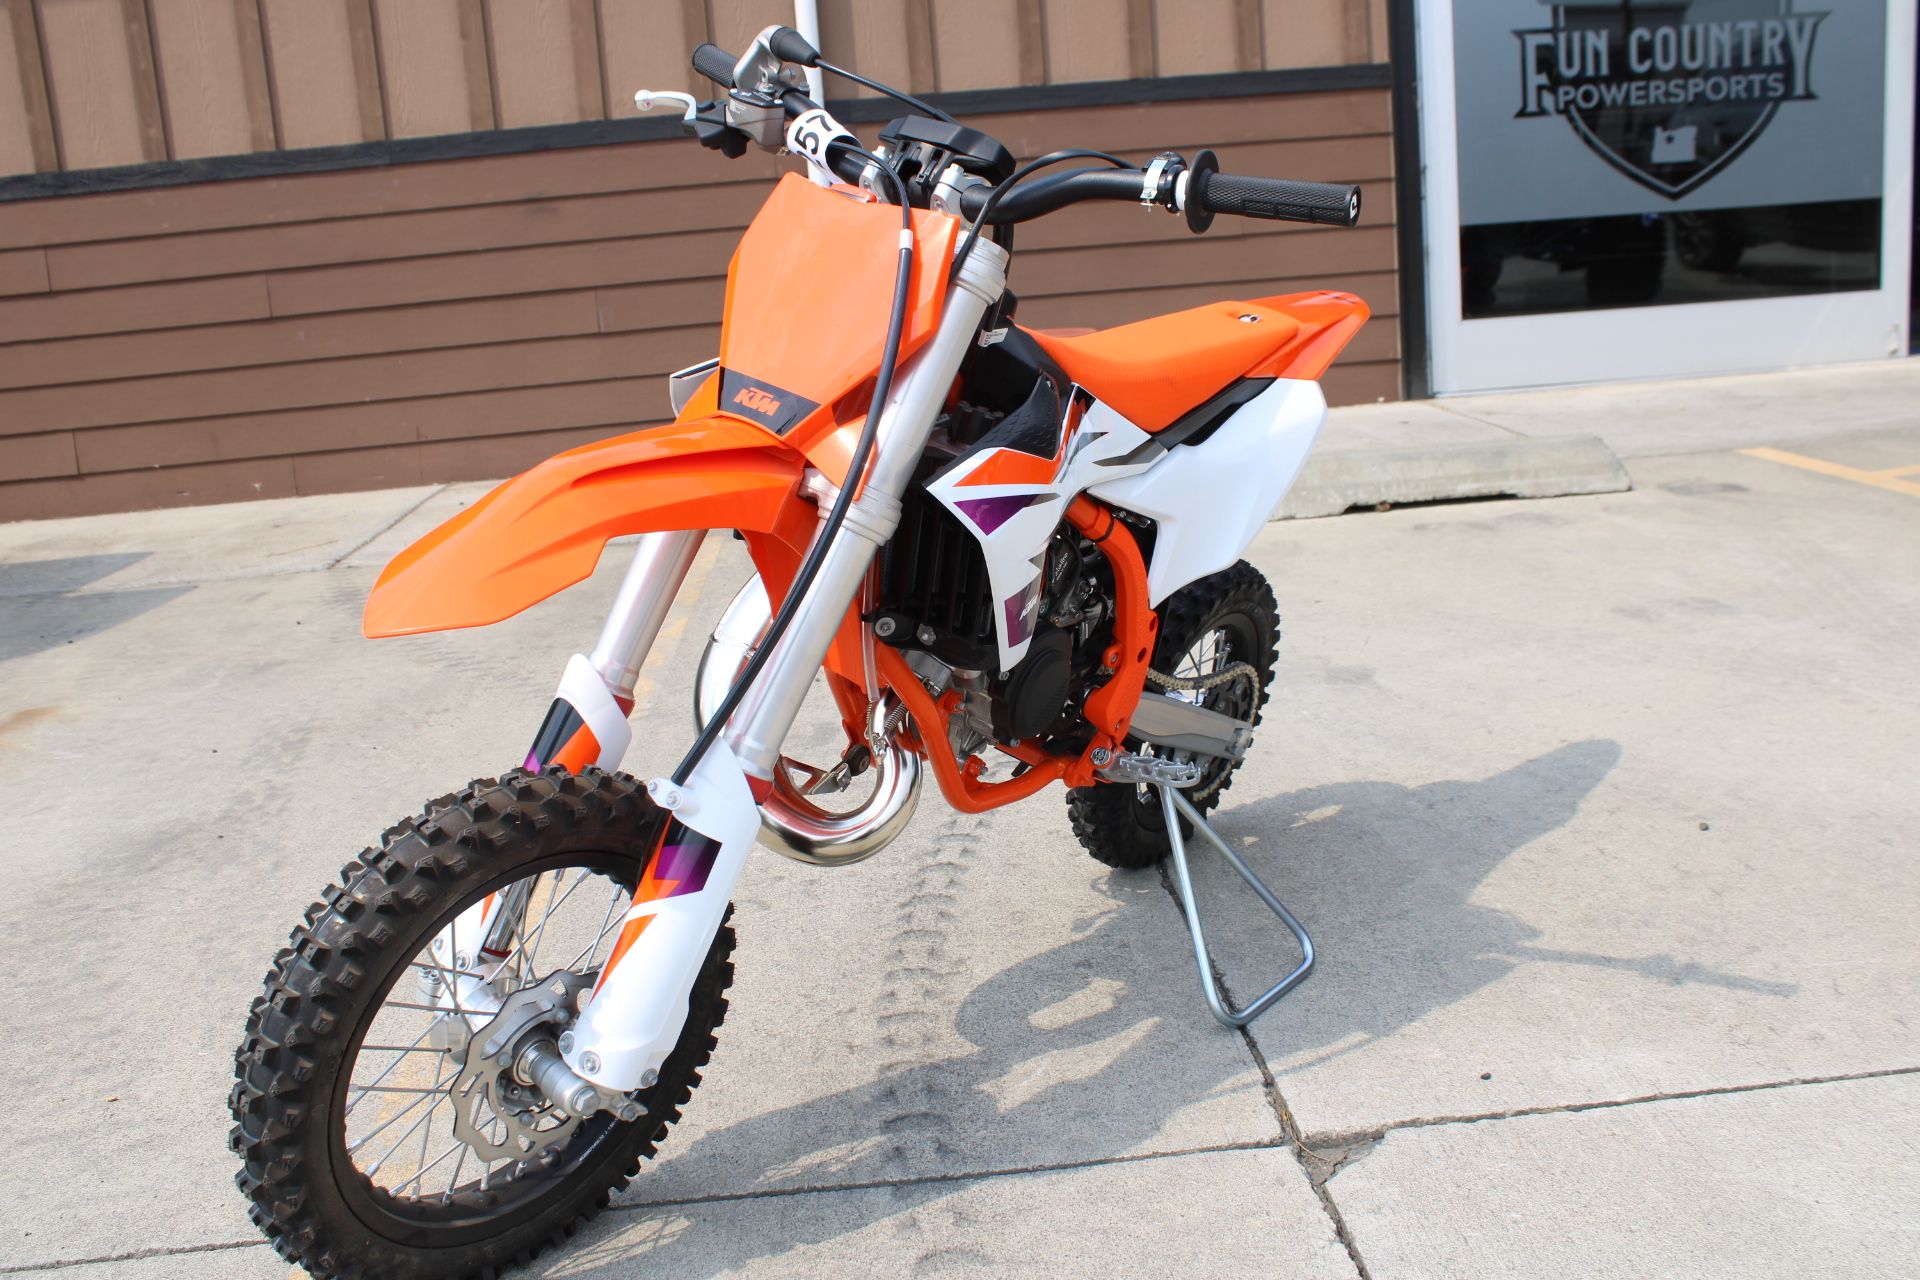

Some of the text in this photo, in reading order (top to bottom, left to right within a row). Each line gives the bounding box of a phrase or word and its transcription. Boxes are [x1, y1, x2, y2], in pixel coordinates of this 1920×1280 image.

[1513, 10, 1831, 118] FUN COUNTRY
[1557, 73, 1785, 112] POWERSPORTS
[794, 114, 833, 170] 57
[733, 387, 782, 417] KTM
